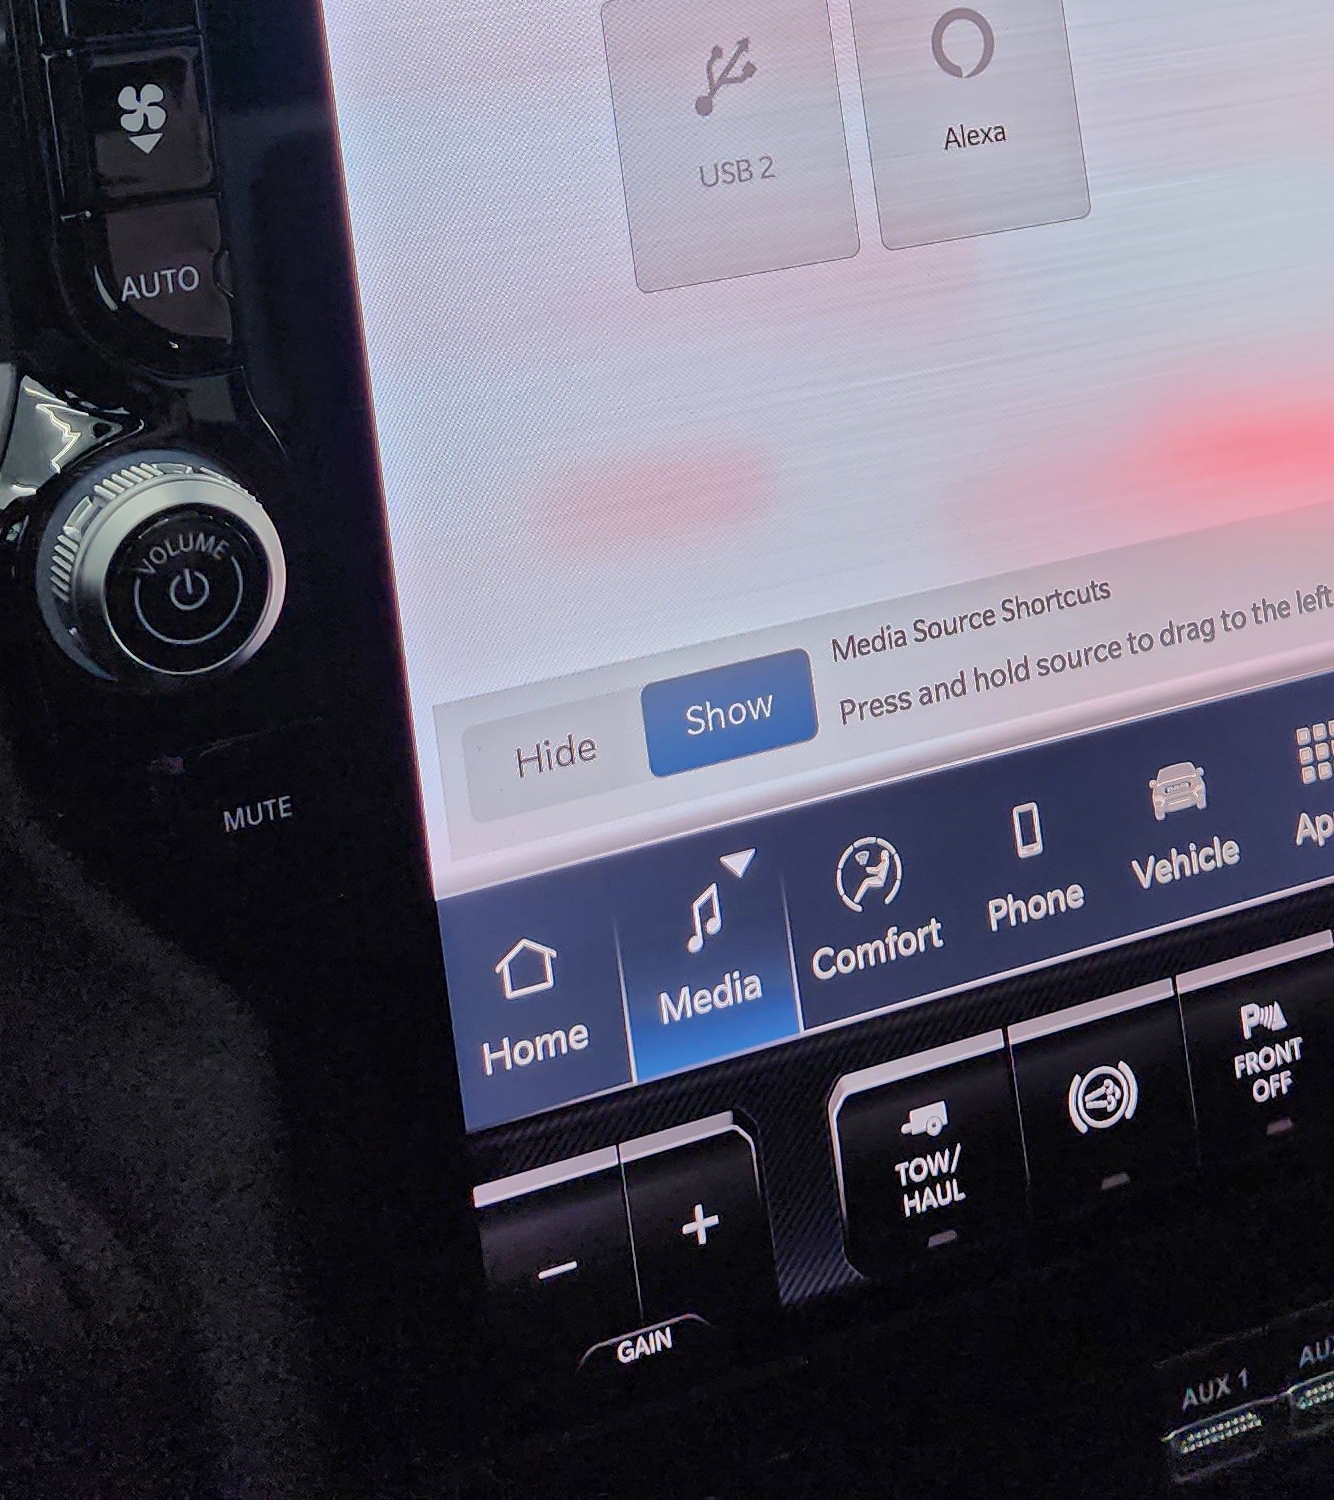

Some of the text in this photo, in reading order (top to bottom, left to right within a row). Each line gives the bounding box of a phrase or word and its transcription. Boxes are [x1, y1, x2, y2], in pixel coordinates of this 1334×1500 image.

[943, 118, 1008, 150] Alexa
[698, 156, 776, 189] USB 2
[120, 265, 201, 302] AUTO
[136, 532, 231, 579] VOLUME
[832, 578, 1112, 664] Media Source Shortcuts
[839, 583, 1334, 725] Press and hold source to drag to the left
[685, 692, 774, 737] Show
[515, 733, 598, 779] Hide
[223, 794, 293, 833] MUTE
[1131, 835, 1241, 890] Vehicle
[987, 881, 1086, 931] Phone
[811, 916, 945, 981] Comfort
[658, 969, 763, 1025] Media
[482, 1022, 590, 1077] Home
[1234, 1036, 1302, 1080] FRONT
[1252, 1069, 1293, 1103] OFF
[895, 1142, 962, 1187] TOW/
[903, 1178, 967, 1218] HAUL
[616, 1326, 673, 1364] GAIN
[1181, 1369, 1248, 1410] AUX 1
